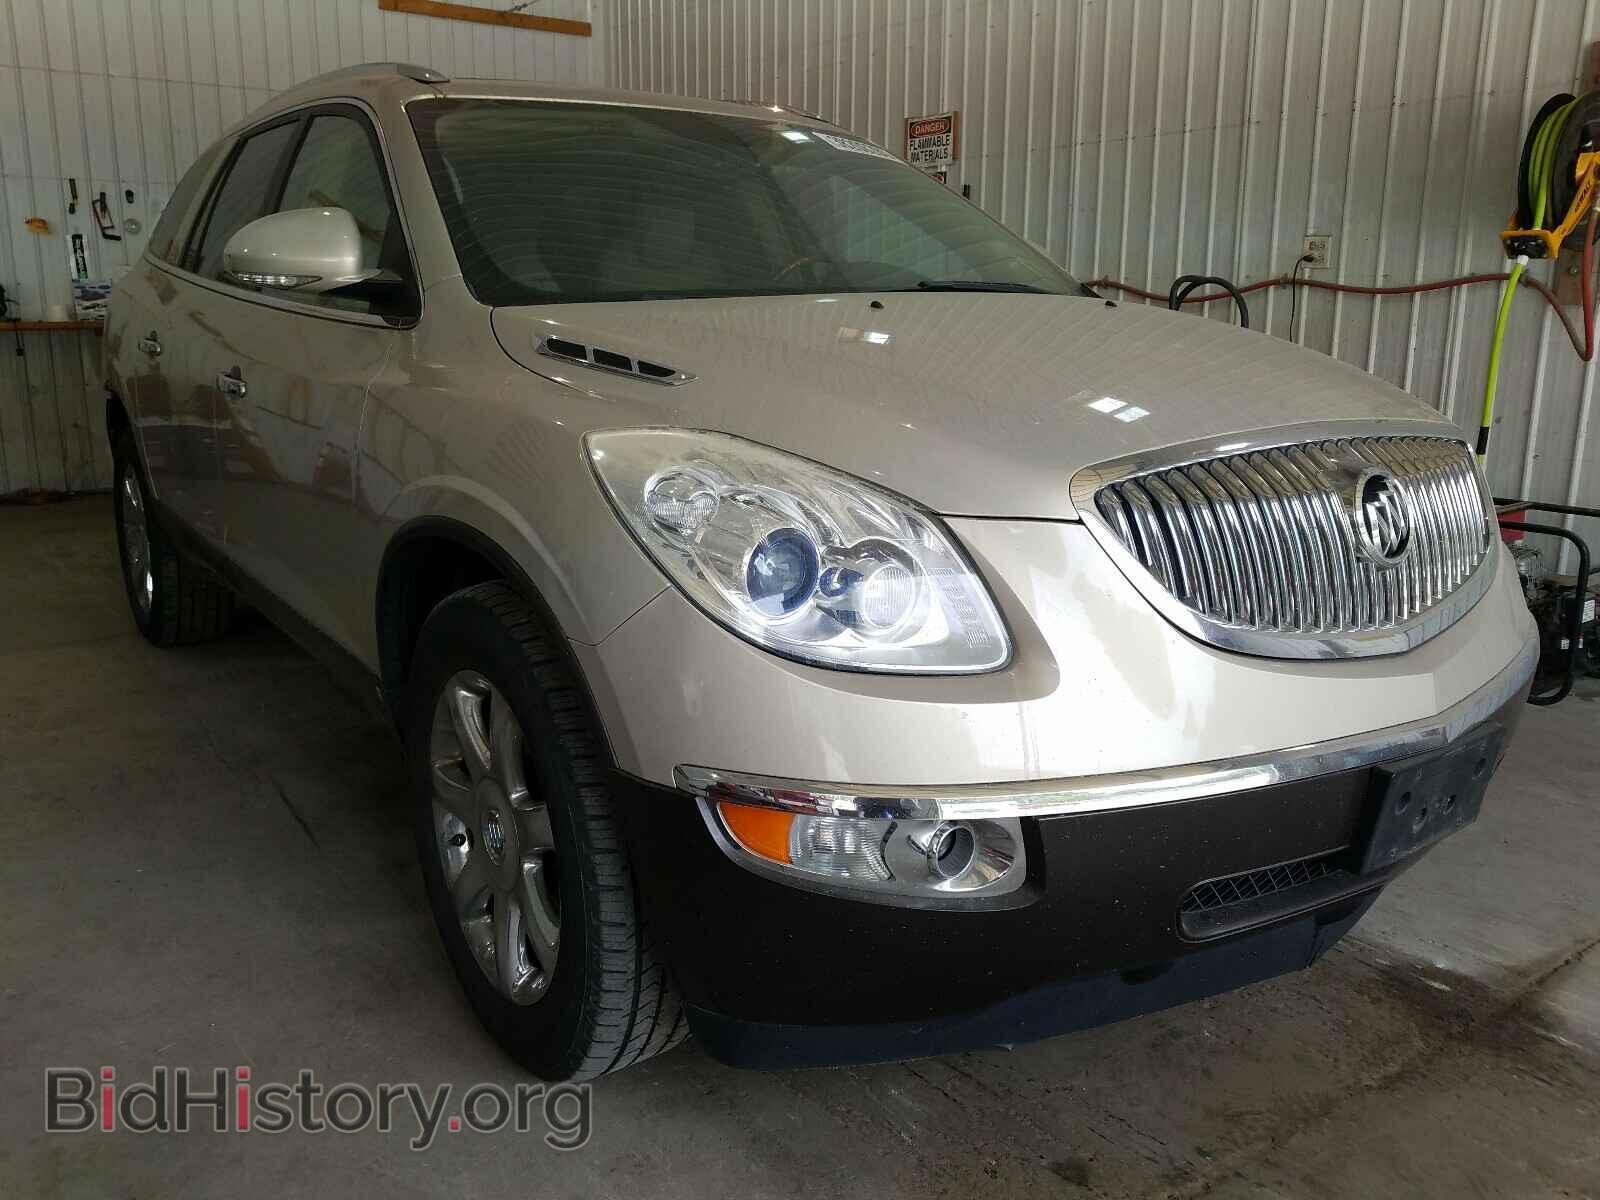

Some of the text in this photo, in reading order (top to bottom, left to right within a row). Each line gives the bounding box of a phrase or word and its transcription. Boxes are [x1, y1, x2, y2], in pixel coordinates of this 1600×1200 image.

[915, 121, 945, 135] DANGER
[909, 134, 951, 152] FLAMMABLE
[910, 147, 949, 163] MATERIALS
